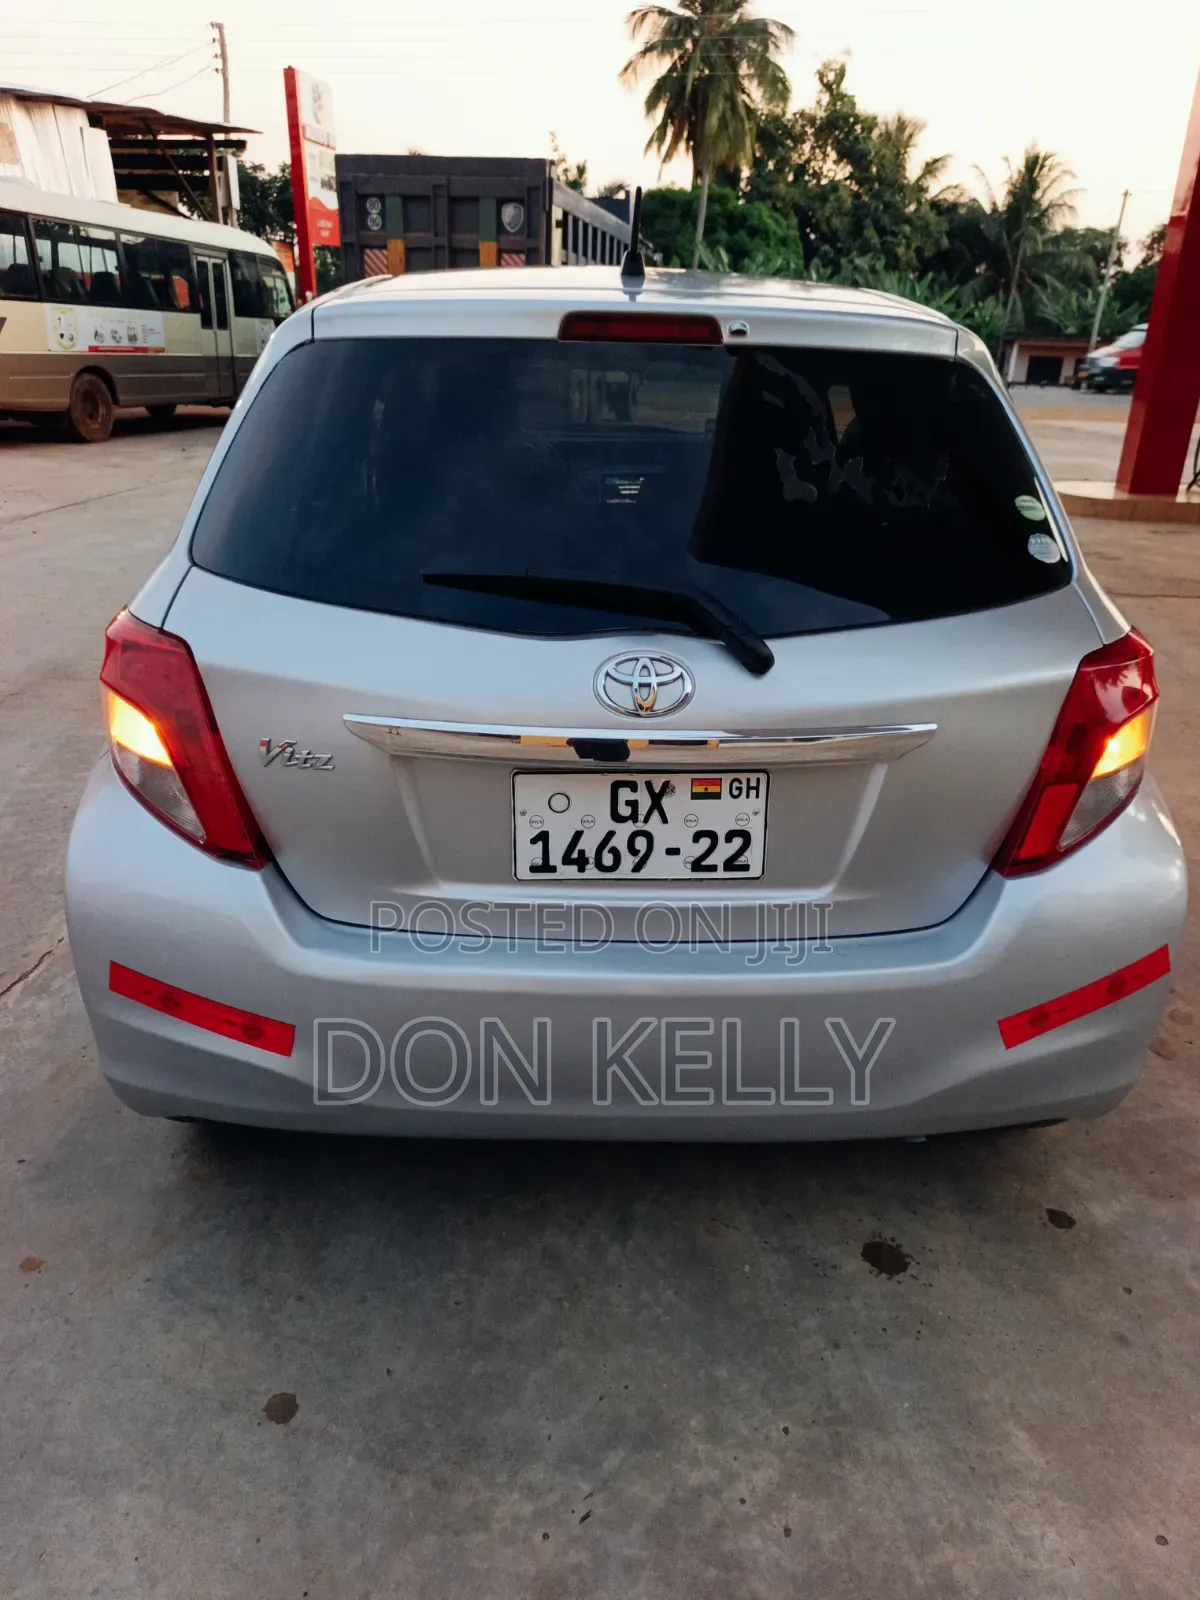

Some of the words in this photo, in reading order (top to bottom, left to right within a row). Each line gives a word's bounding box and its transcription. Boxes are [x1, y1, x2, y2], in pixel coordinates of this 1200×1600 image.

[259, 737, 335, 771] Vitz
[610, 780, 671, 824] GX
[728, 777, 760, 799] GH
[529, 829, 752, 873] 1469-22
